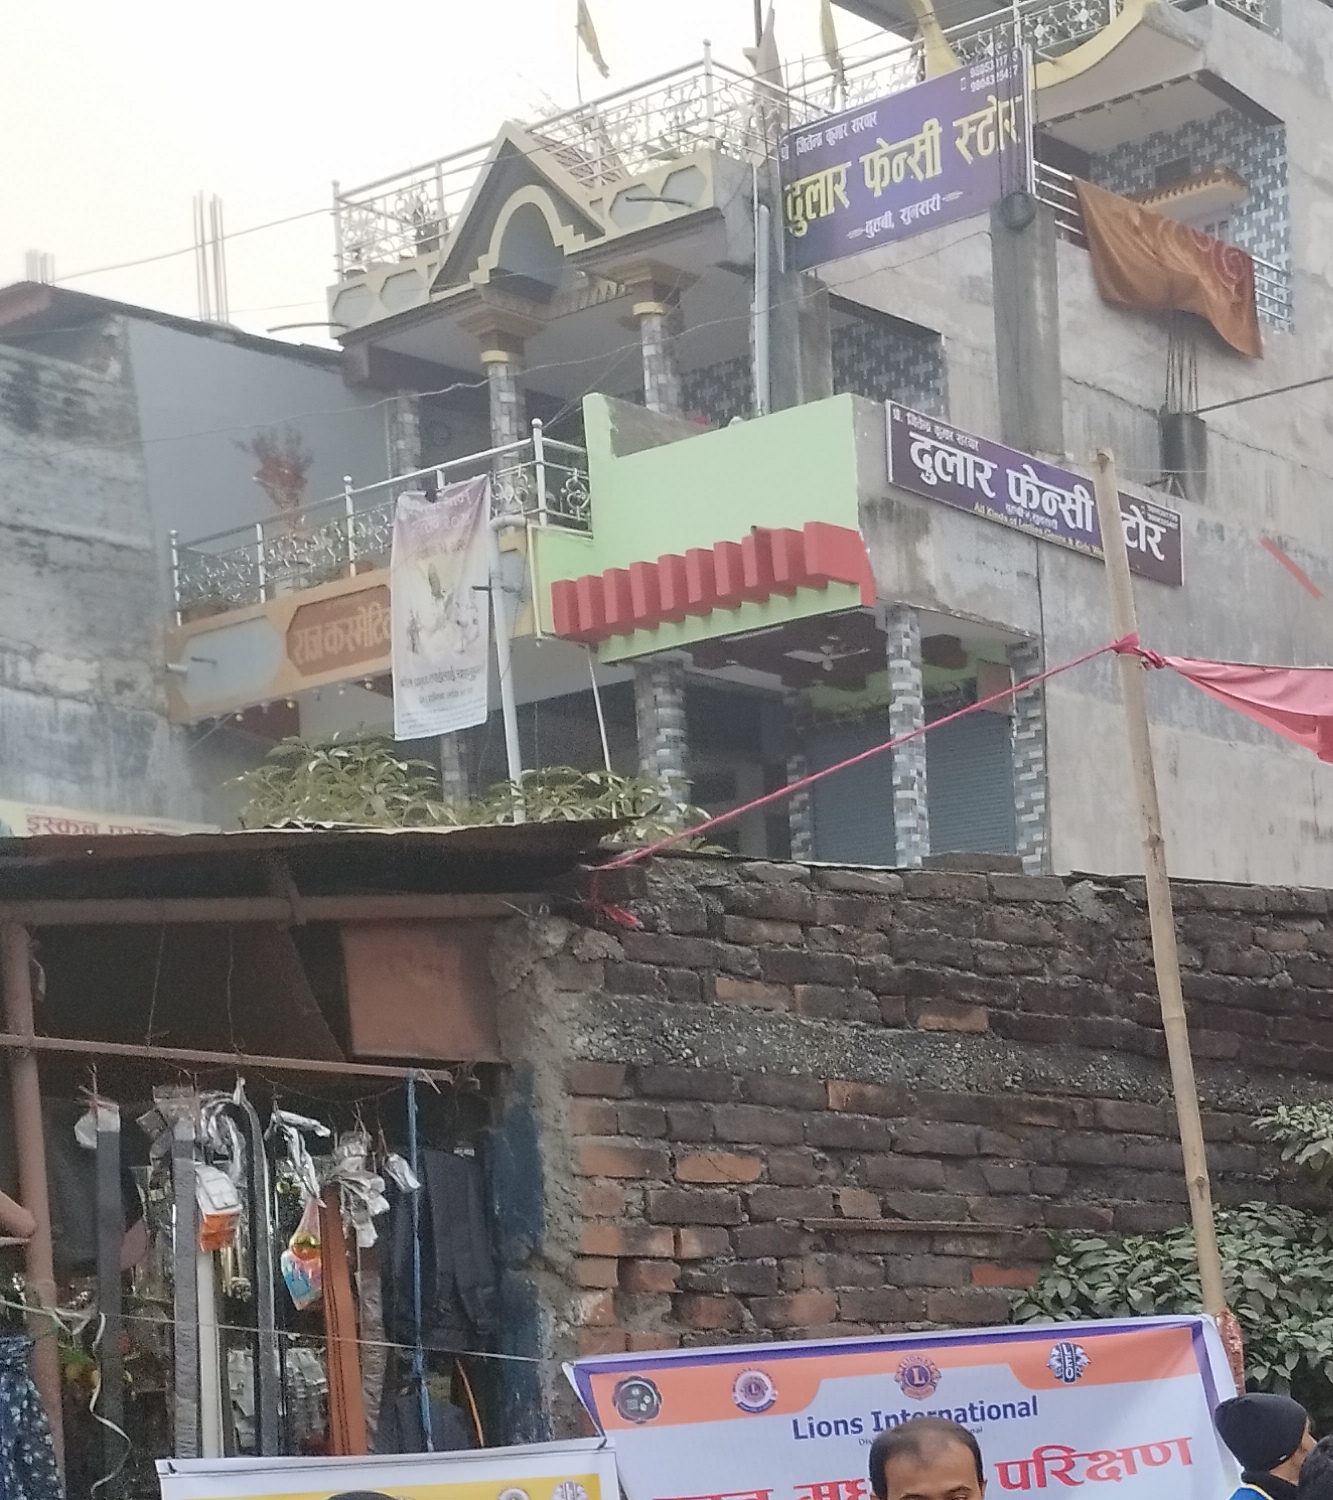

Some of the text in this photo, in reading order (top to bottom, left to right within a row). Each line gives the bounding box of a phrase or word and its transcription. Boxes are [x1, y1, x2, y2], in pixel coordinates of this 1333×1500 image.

[784, 161, 852, 238] दुलार
[858, 117, 943, 198] फेन्सी
[908, 431, 998, 499] दुलार
[1006, 463, 1095, 533] फेन्सी
[1120, 503, 1166, 562] टोर
[792, 1412, 864, 1441] Lions
[994, 1437, 1193, 1490] परिक्षण
